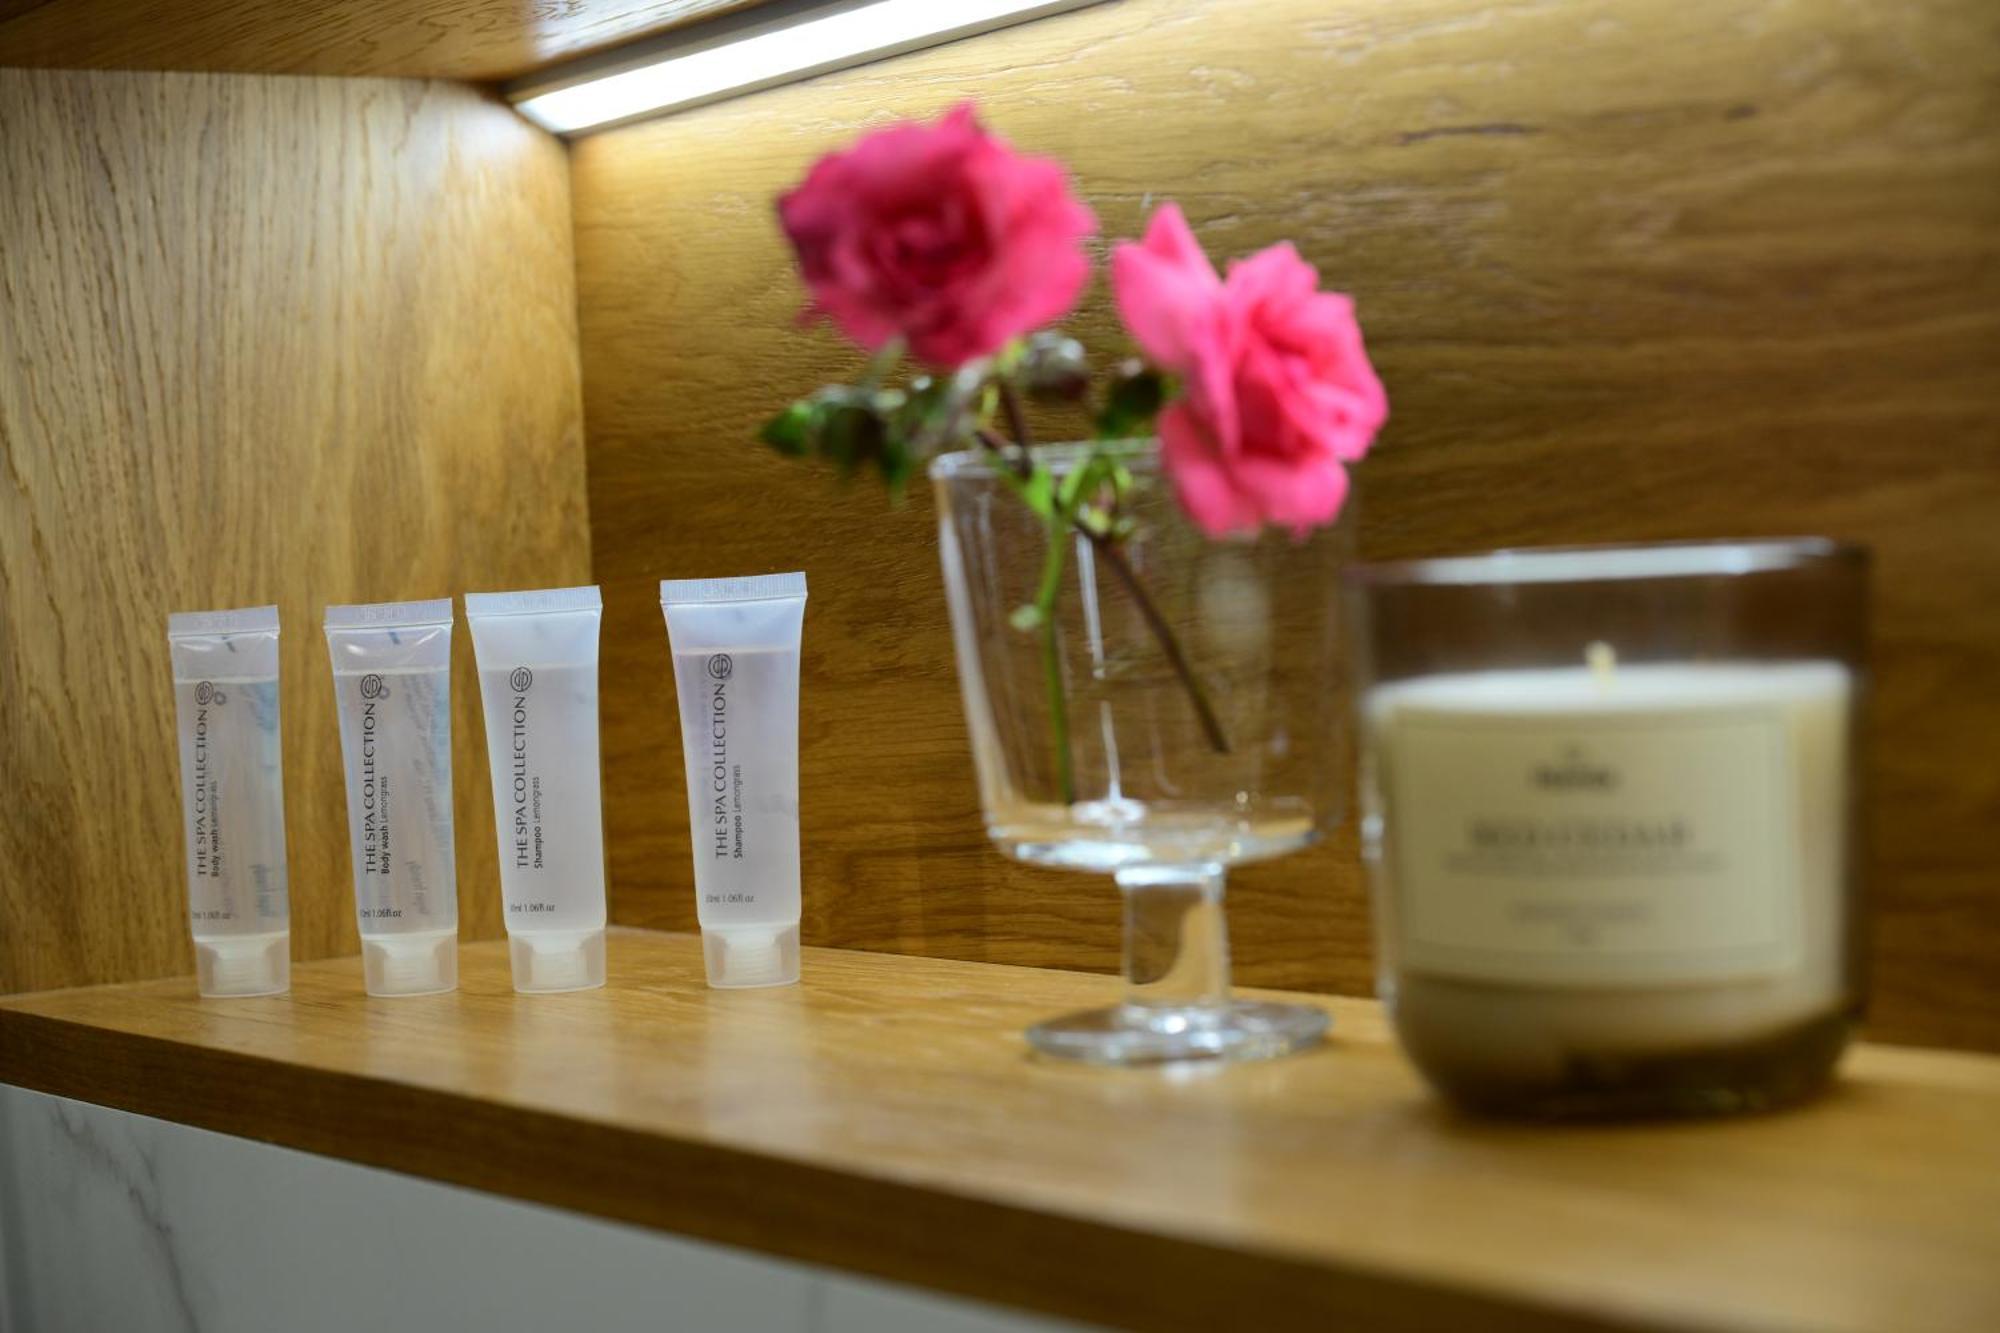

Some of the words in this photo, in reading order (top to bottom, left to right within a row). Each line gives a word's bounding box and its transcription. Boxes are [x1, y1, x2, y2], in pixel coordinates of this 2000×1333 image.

[513, 697, 527, 803] COLLECTION
[712, 684, 727, 792] COLLECTION
[195, 709, 209, 813] COLLECTION
[363, 703, 377, 810] COLLECTION
[380, 776, 391, 823] Lemongrass
[532, 776, 543, 823] Lemongrass
[714, 795, 728, 825] SPA
[196, 817, 207, 844] SPA
[364, 812, 377, 841] SPA
[515, 806, 528, 836] SPA
[210, 829, 220, 853] wash
[380, 825, 390, 849] wash
[534, 826, 545, 869] Shampoo
[715, 828, 729, 859] THE
[733, 815, 744, 859] Shampoo
[197, 847, 208, 877] THE
[211, 855, 222, 877] Body
[364, 844, 377, 874] THE
[380, 851, 392, 874] Body
[516, 838, 529, 868] THE
